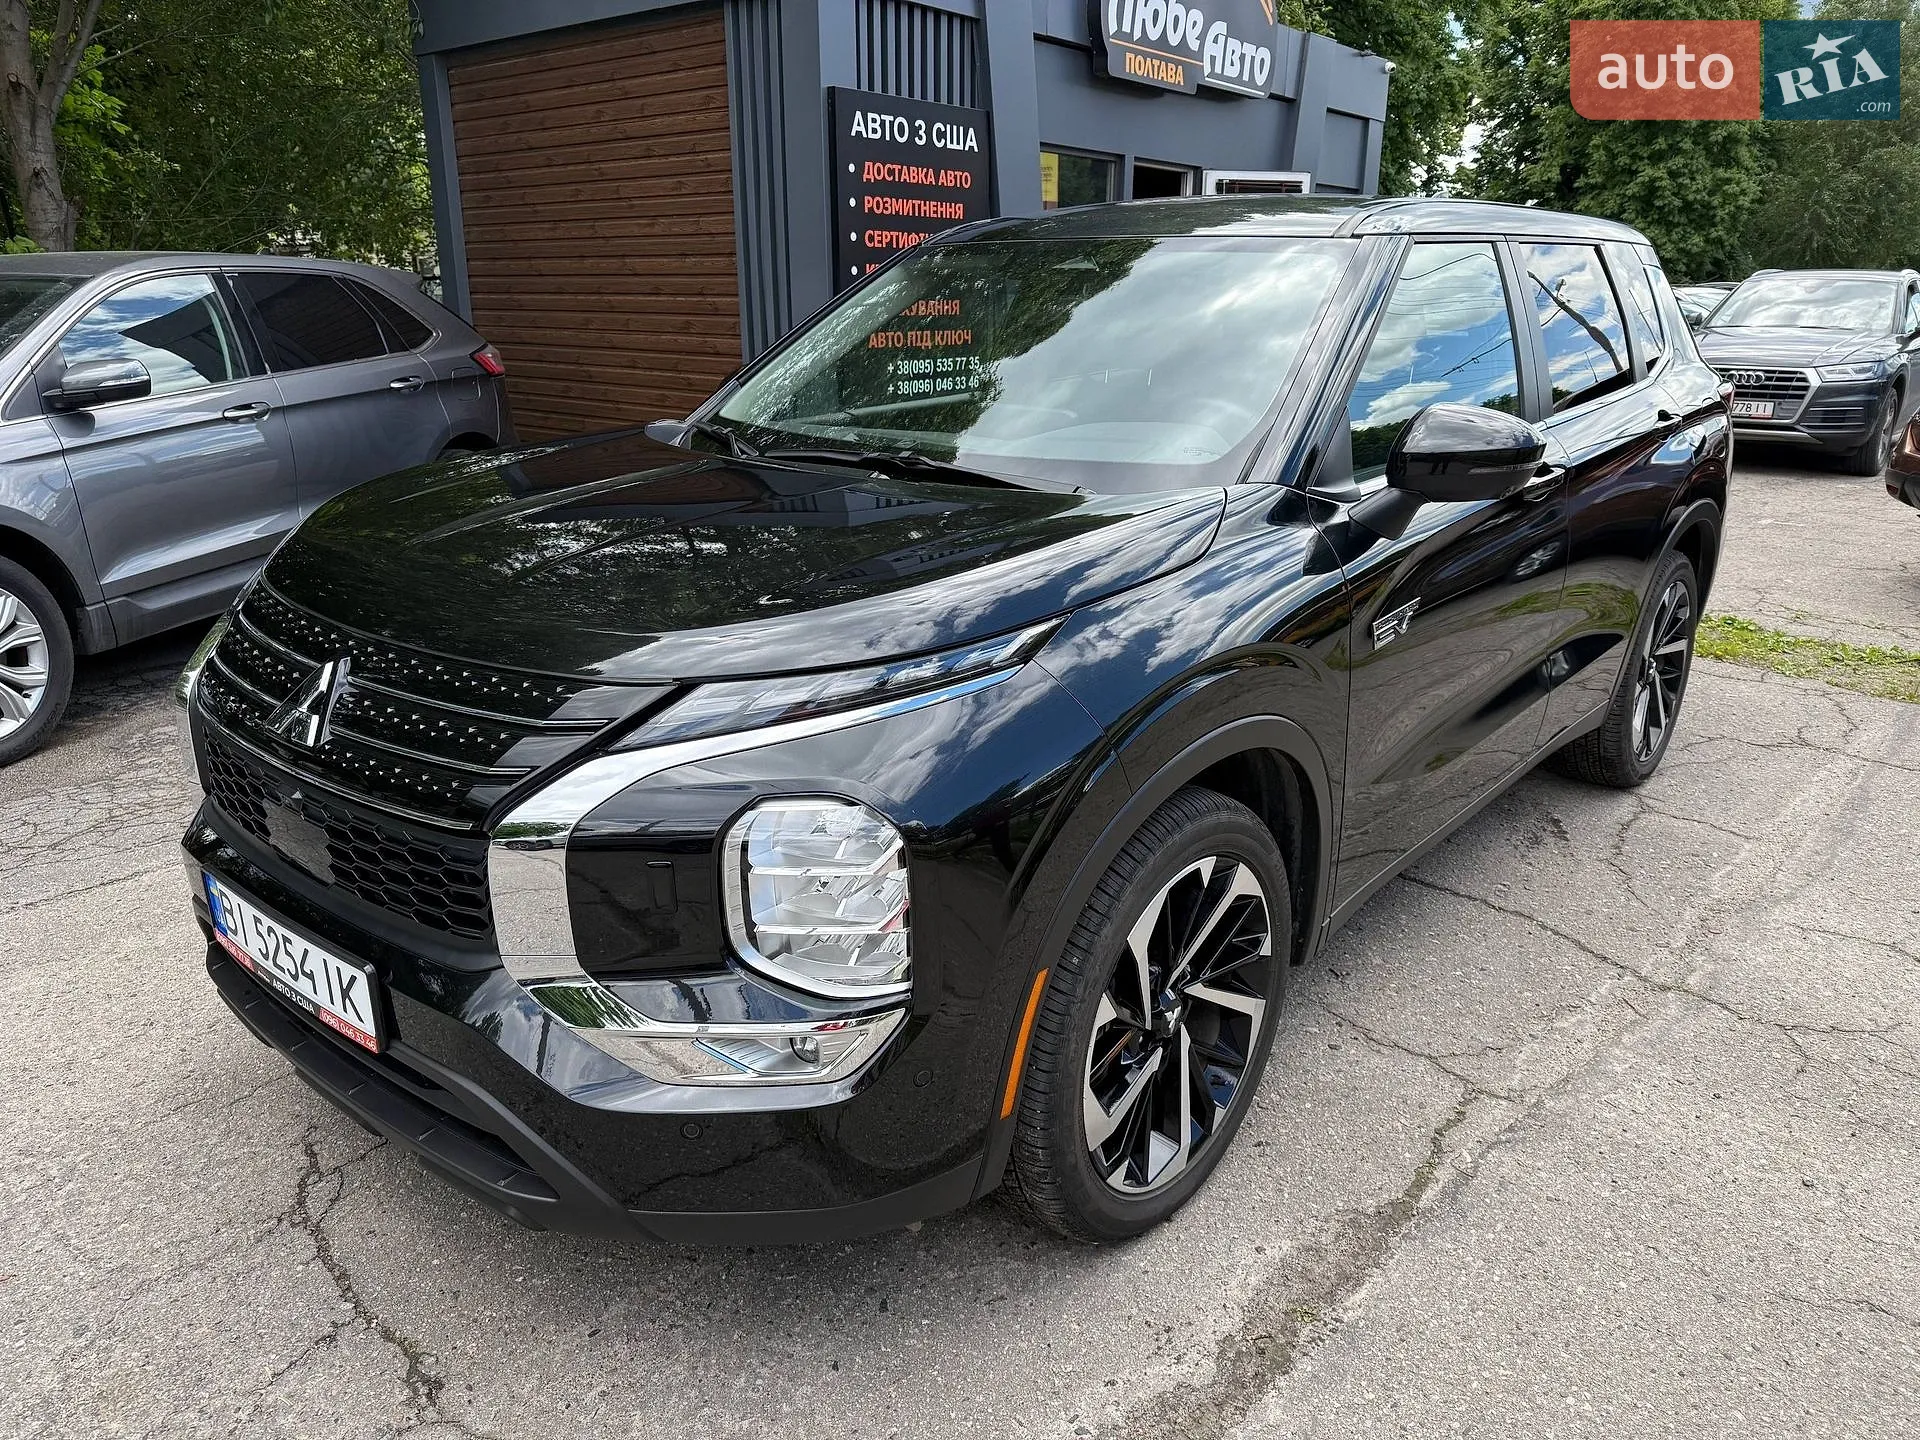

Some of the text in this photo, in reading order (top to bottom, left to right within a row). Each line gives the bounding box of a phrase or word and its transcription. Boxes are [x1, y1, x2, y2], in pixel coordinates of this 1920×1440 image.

[1203, 20, 1271, 86] Авто
[1124, 52, 1184, 86] ПОЛТАВА
[850, 110, 909, 143] АВТО
[932, 122, 979, 152] США
[862, 161, 971, 189] ДОСТАВКА АВТО
[864, 195, 964, 220] РОЗМИТНЕННЯ
[864, 230, 933, 249] СЕРТИФІ
[868, 329, 972, 350] АВТО ПІД КЛЮЧ
[897, 359, 934, 377] 38(095)
[936, 359, 954, 372] 535
[955, 357, 967, 371] 77
[968, 356, 980, 370] 35
[897, 378, 934, 396] 38(096)
[936, 378, 953, 392] 046
[955, 377, 967, 390] 33
[968, 376, 980, 389] 46
[219, 889, 365, 1024] BI 5254 IK
[272, 979, 291, 998] АВТО
